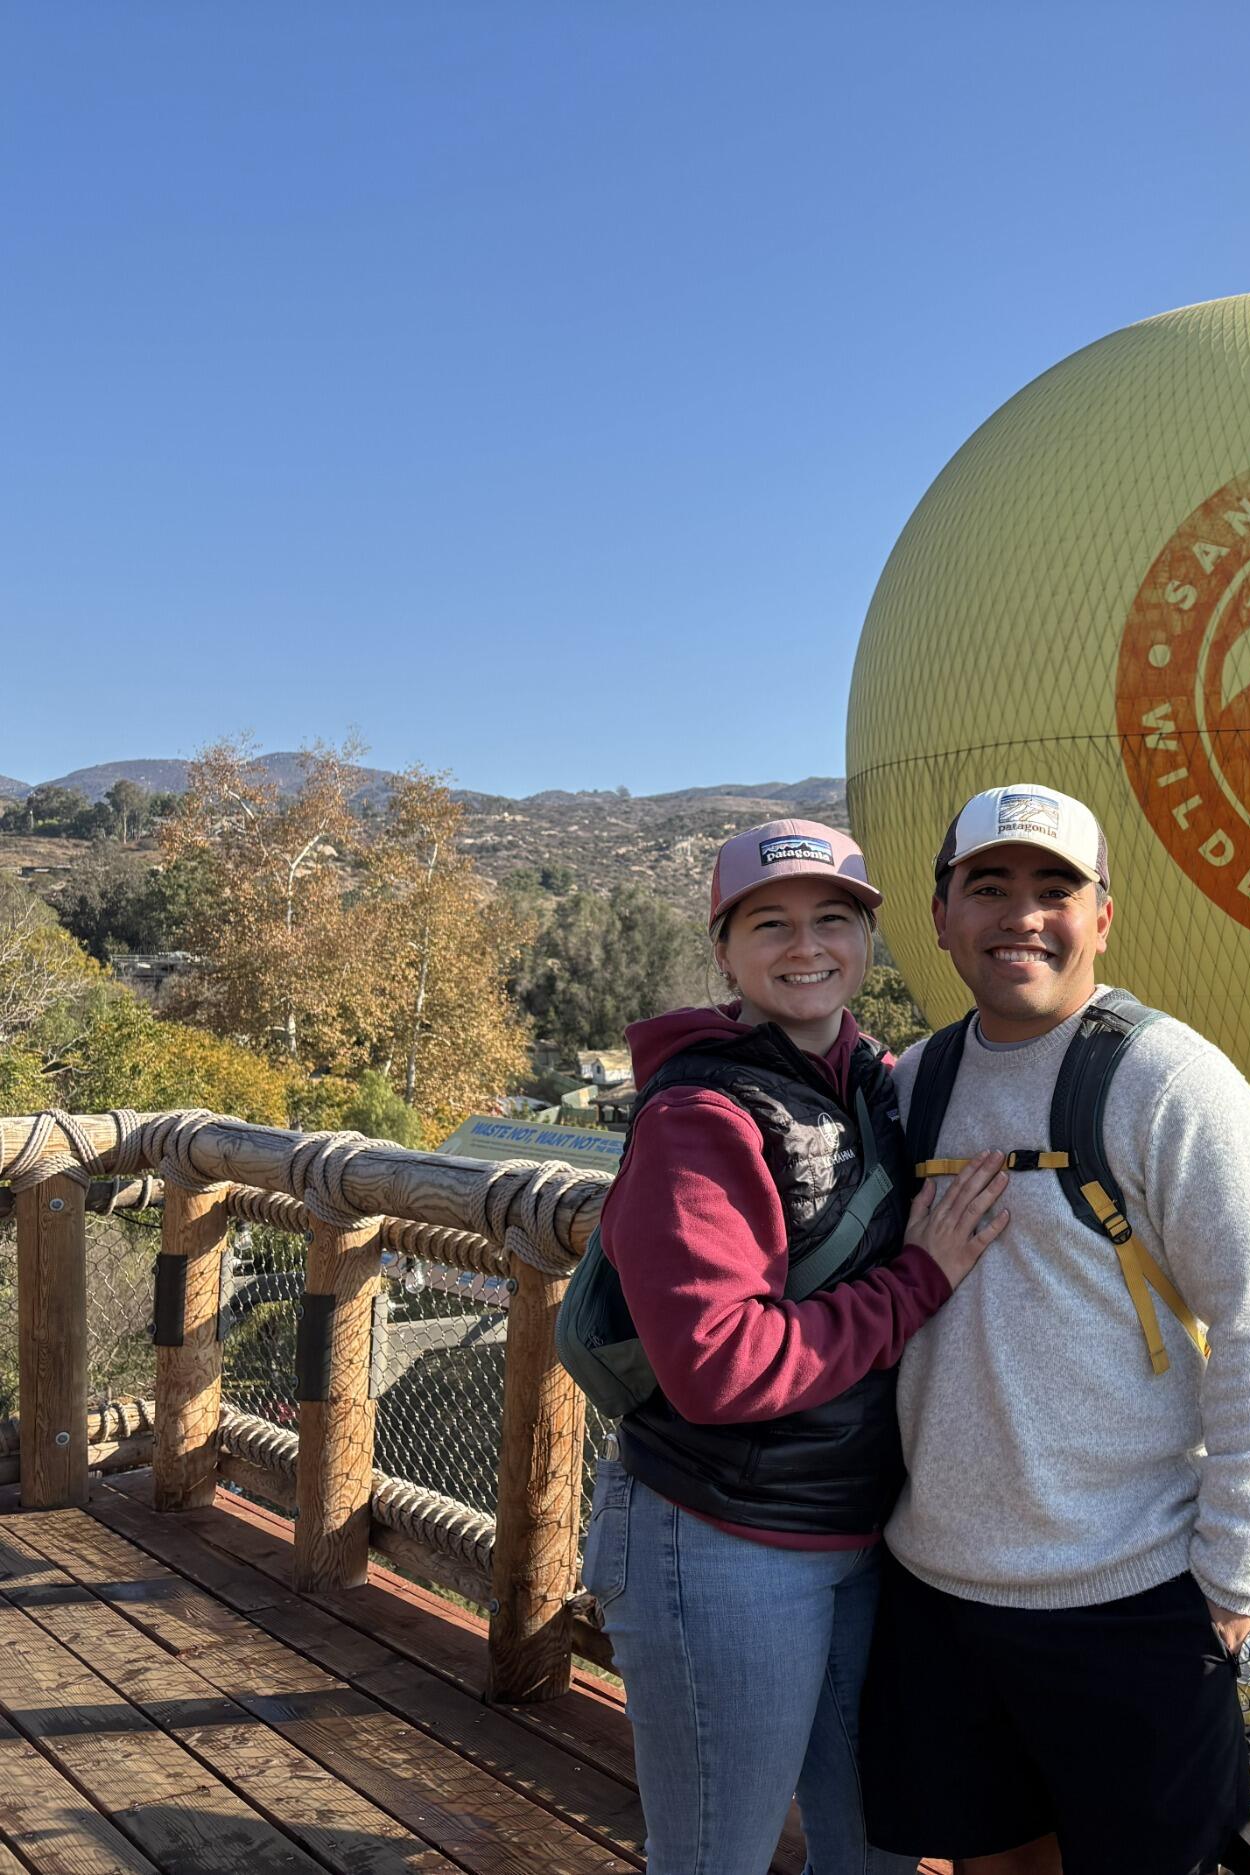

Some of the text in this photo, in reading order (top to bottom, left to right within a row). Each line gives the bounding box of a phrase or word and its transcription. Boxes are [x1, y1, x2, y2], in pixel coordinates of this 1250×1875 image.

[997, 822, 1057, 839] patagonia
[766, 848, 831, 862] patagonia
[470, 1121, 512, 1139] WASTE
[534, 1130, 576, 1148] WANT
[569, 1136, 602, 1151] NOT
